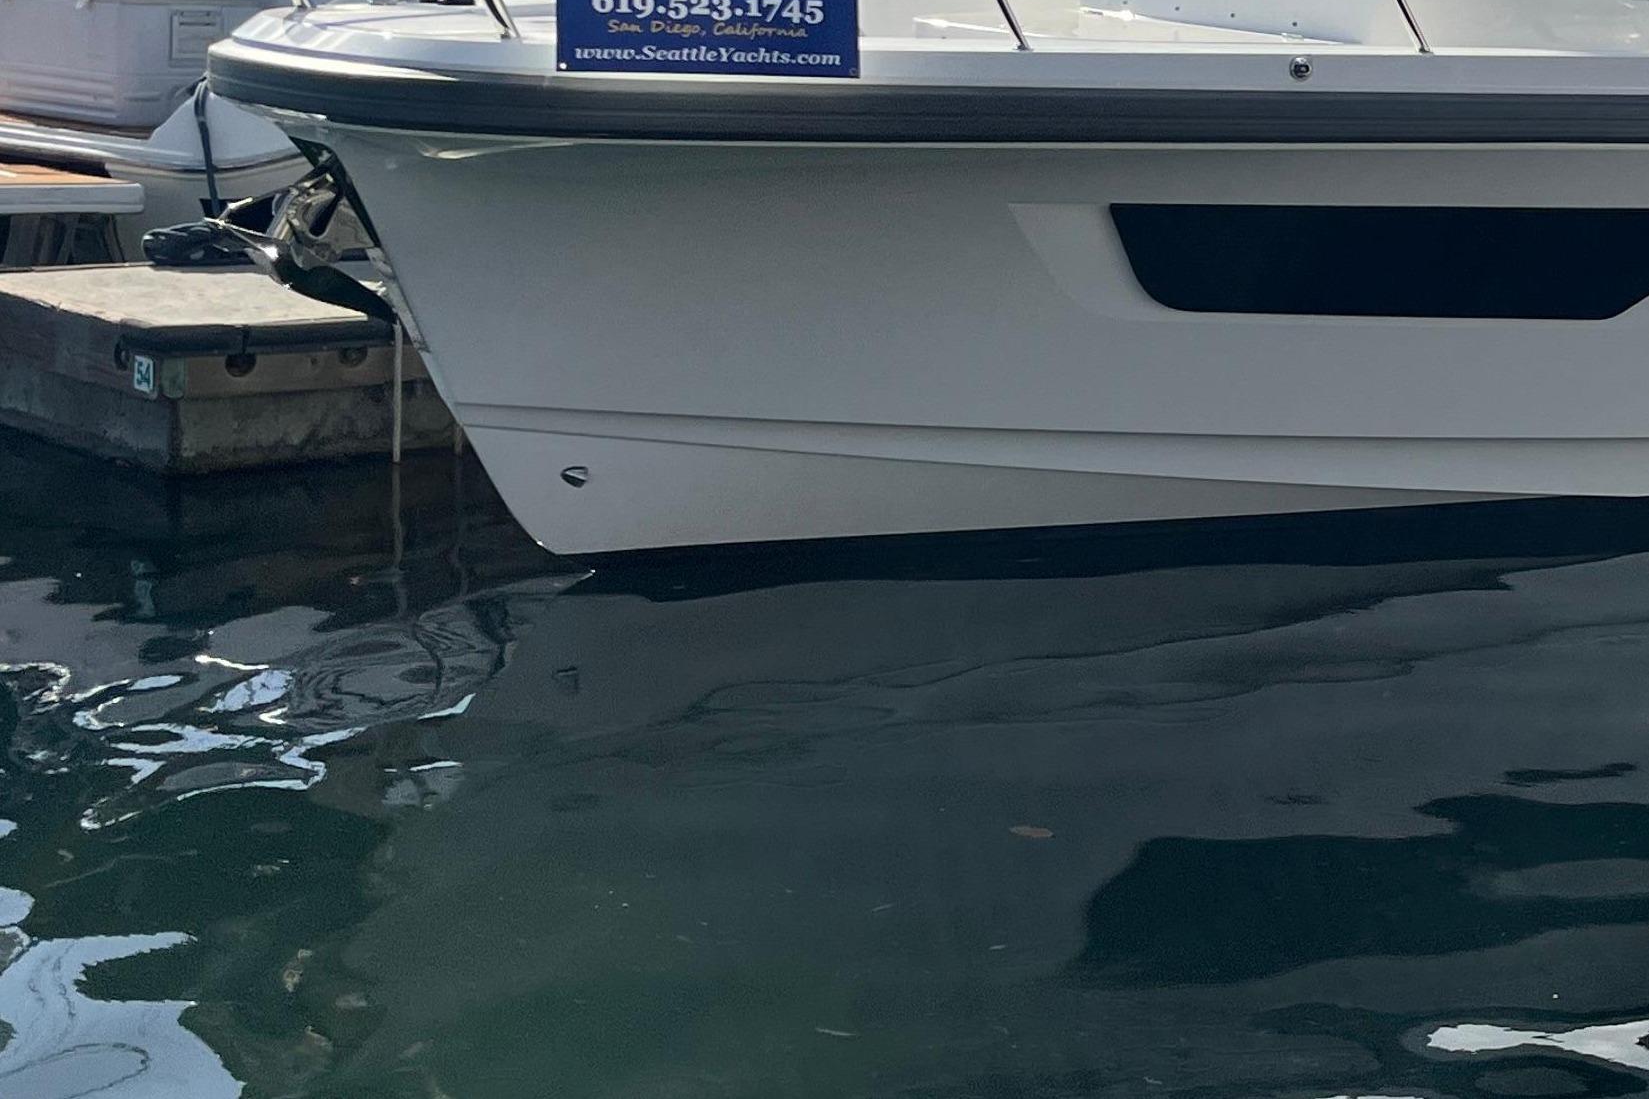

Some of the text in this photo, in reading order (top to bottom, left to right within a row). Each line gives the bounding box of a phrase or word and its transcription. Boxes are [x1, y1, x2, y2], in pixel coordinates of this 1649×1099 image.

[607, 19, 809, 40] San Diego, California
[574, 45, 842, 66] www.SeattleYachts.com
